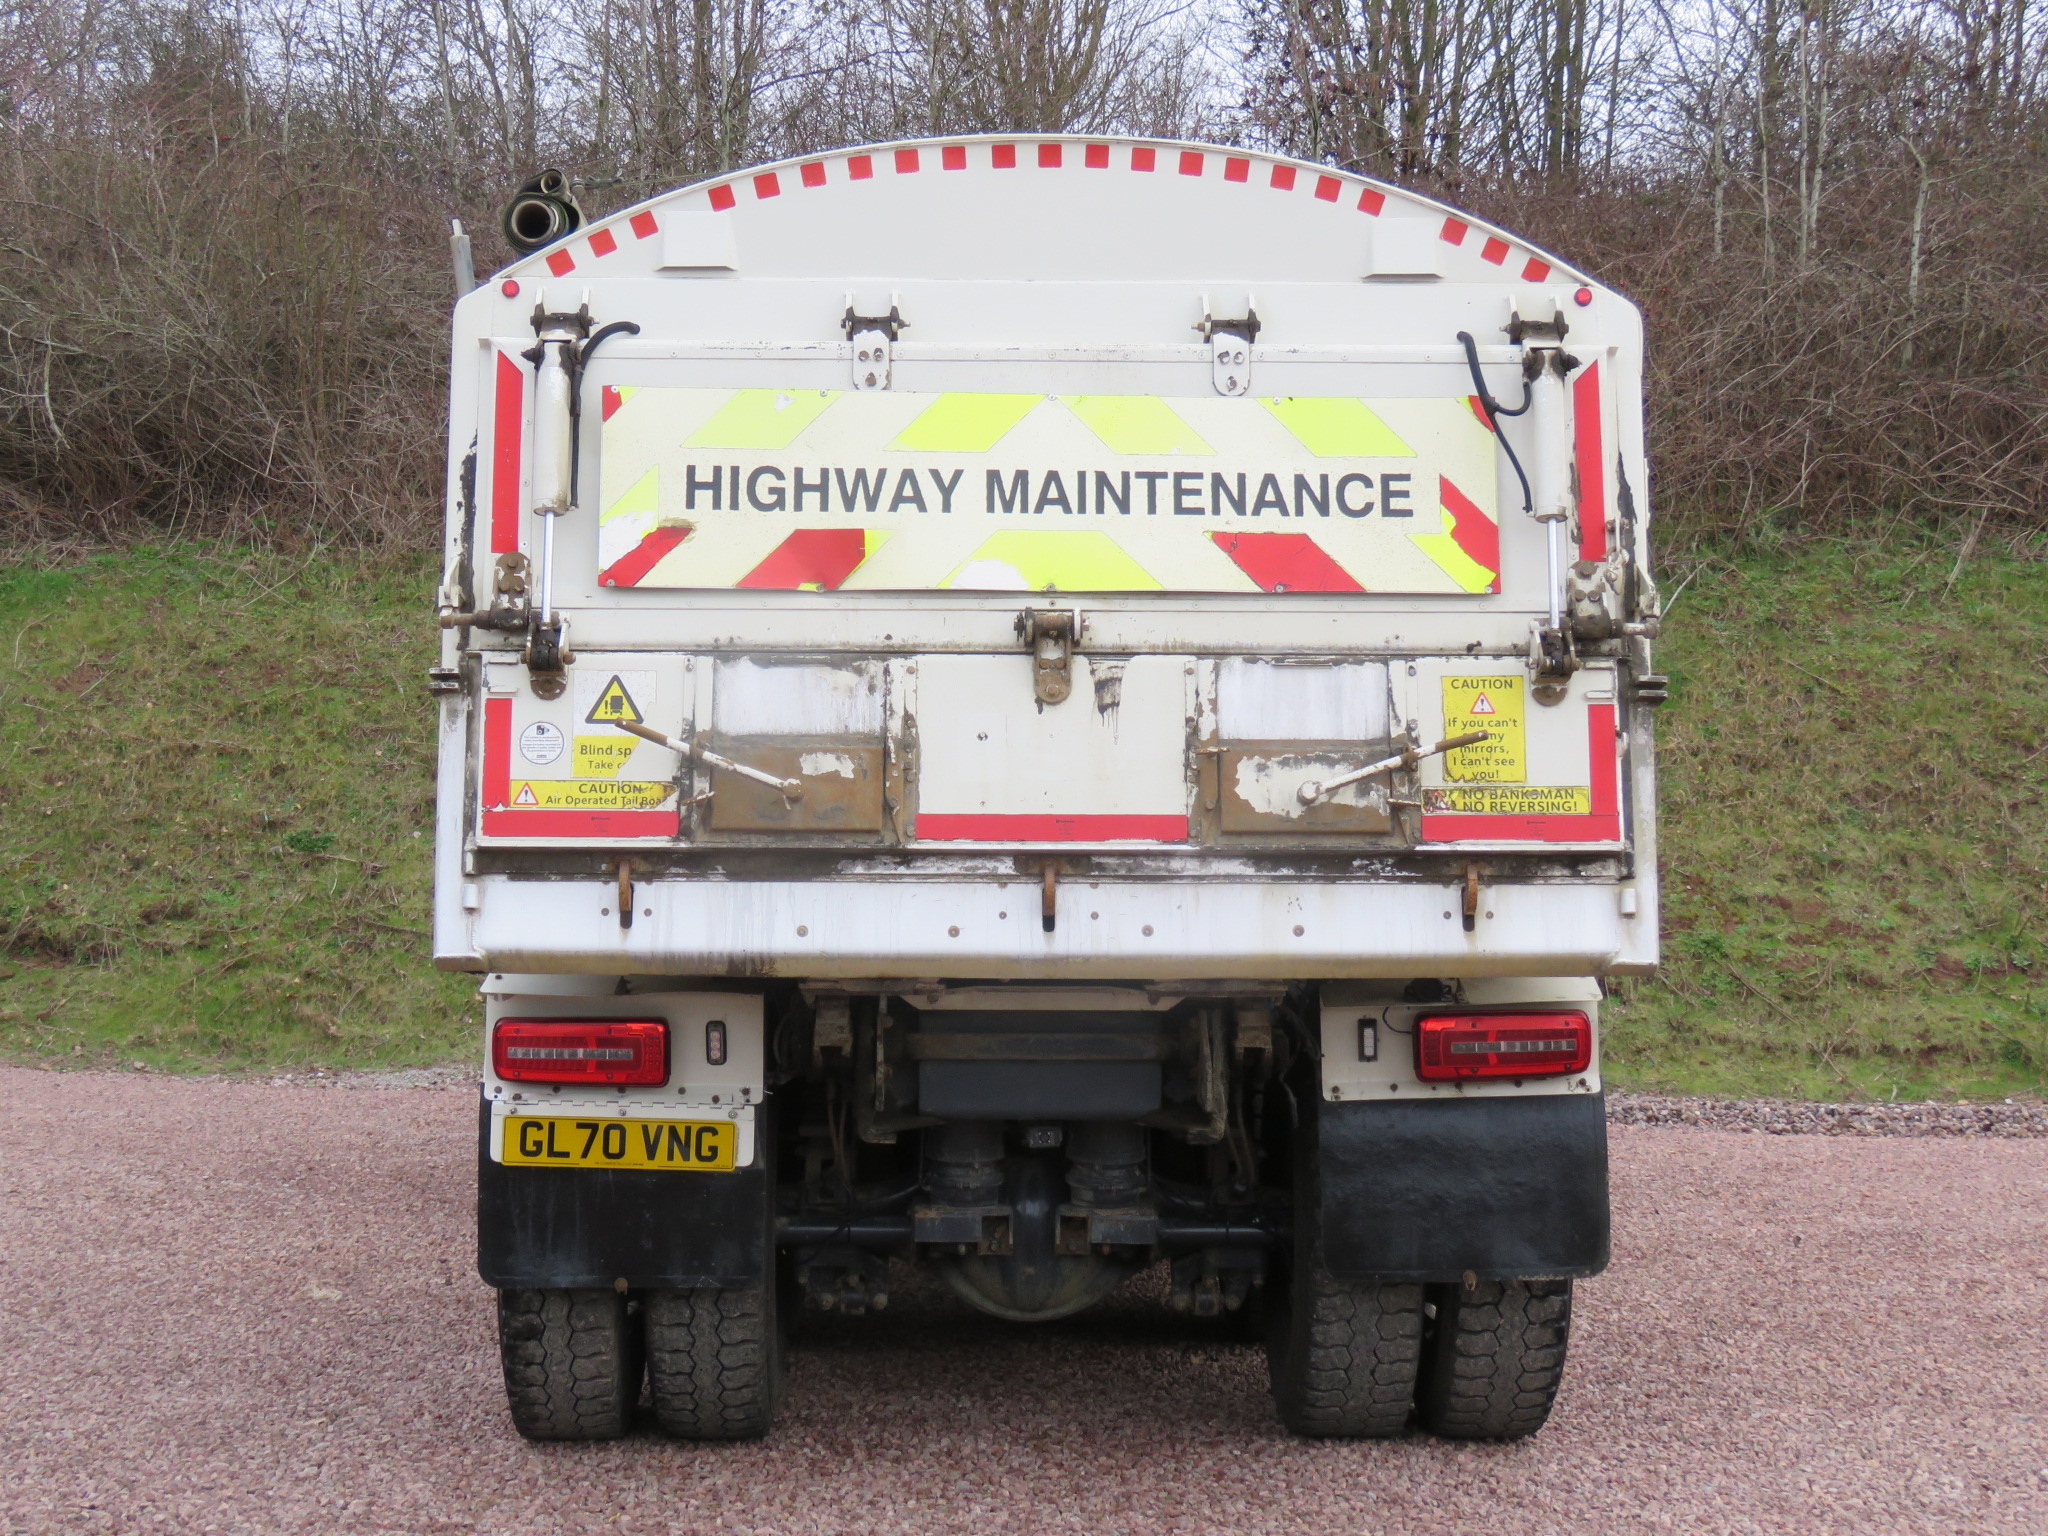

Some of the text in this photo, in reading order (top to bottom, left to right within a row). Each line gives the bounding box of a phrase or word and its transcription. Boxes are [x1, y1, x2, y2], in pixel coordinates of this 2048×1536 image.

[685, 464, 1414, 518] HIGHWAY MAINTENANCE
[1451, 679, 1513, 689] CAUTION
[1448, 717, 1518, 730] If you can't
[580, 744, 613, 755] Blind
[1460, 743, 1509, 754] mirrors,
[588, 760, 614, 769] Take
[1461, 757, 1491, 766] can't
[1494, 758, 1516, 766] see
[1472, 770, 1499, 781] you!
[578, 783, 642, 794] CAUTION
[1463, 789, 1485, 800] NO
[546, 795, 562, 805] Air
[565, 795, 617, 806] Operated
[621, 796, 638, 805] Tail
[1463, 801, 1578, 812] NO REVERSING!
[519, 1120, 719, 1162] GL70 VNG
